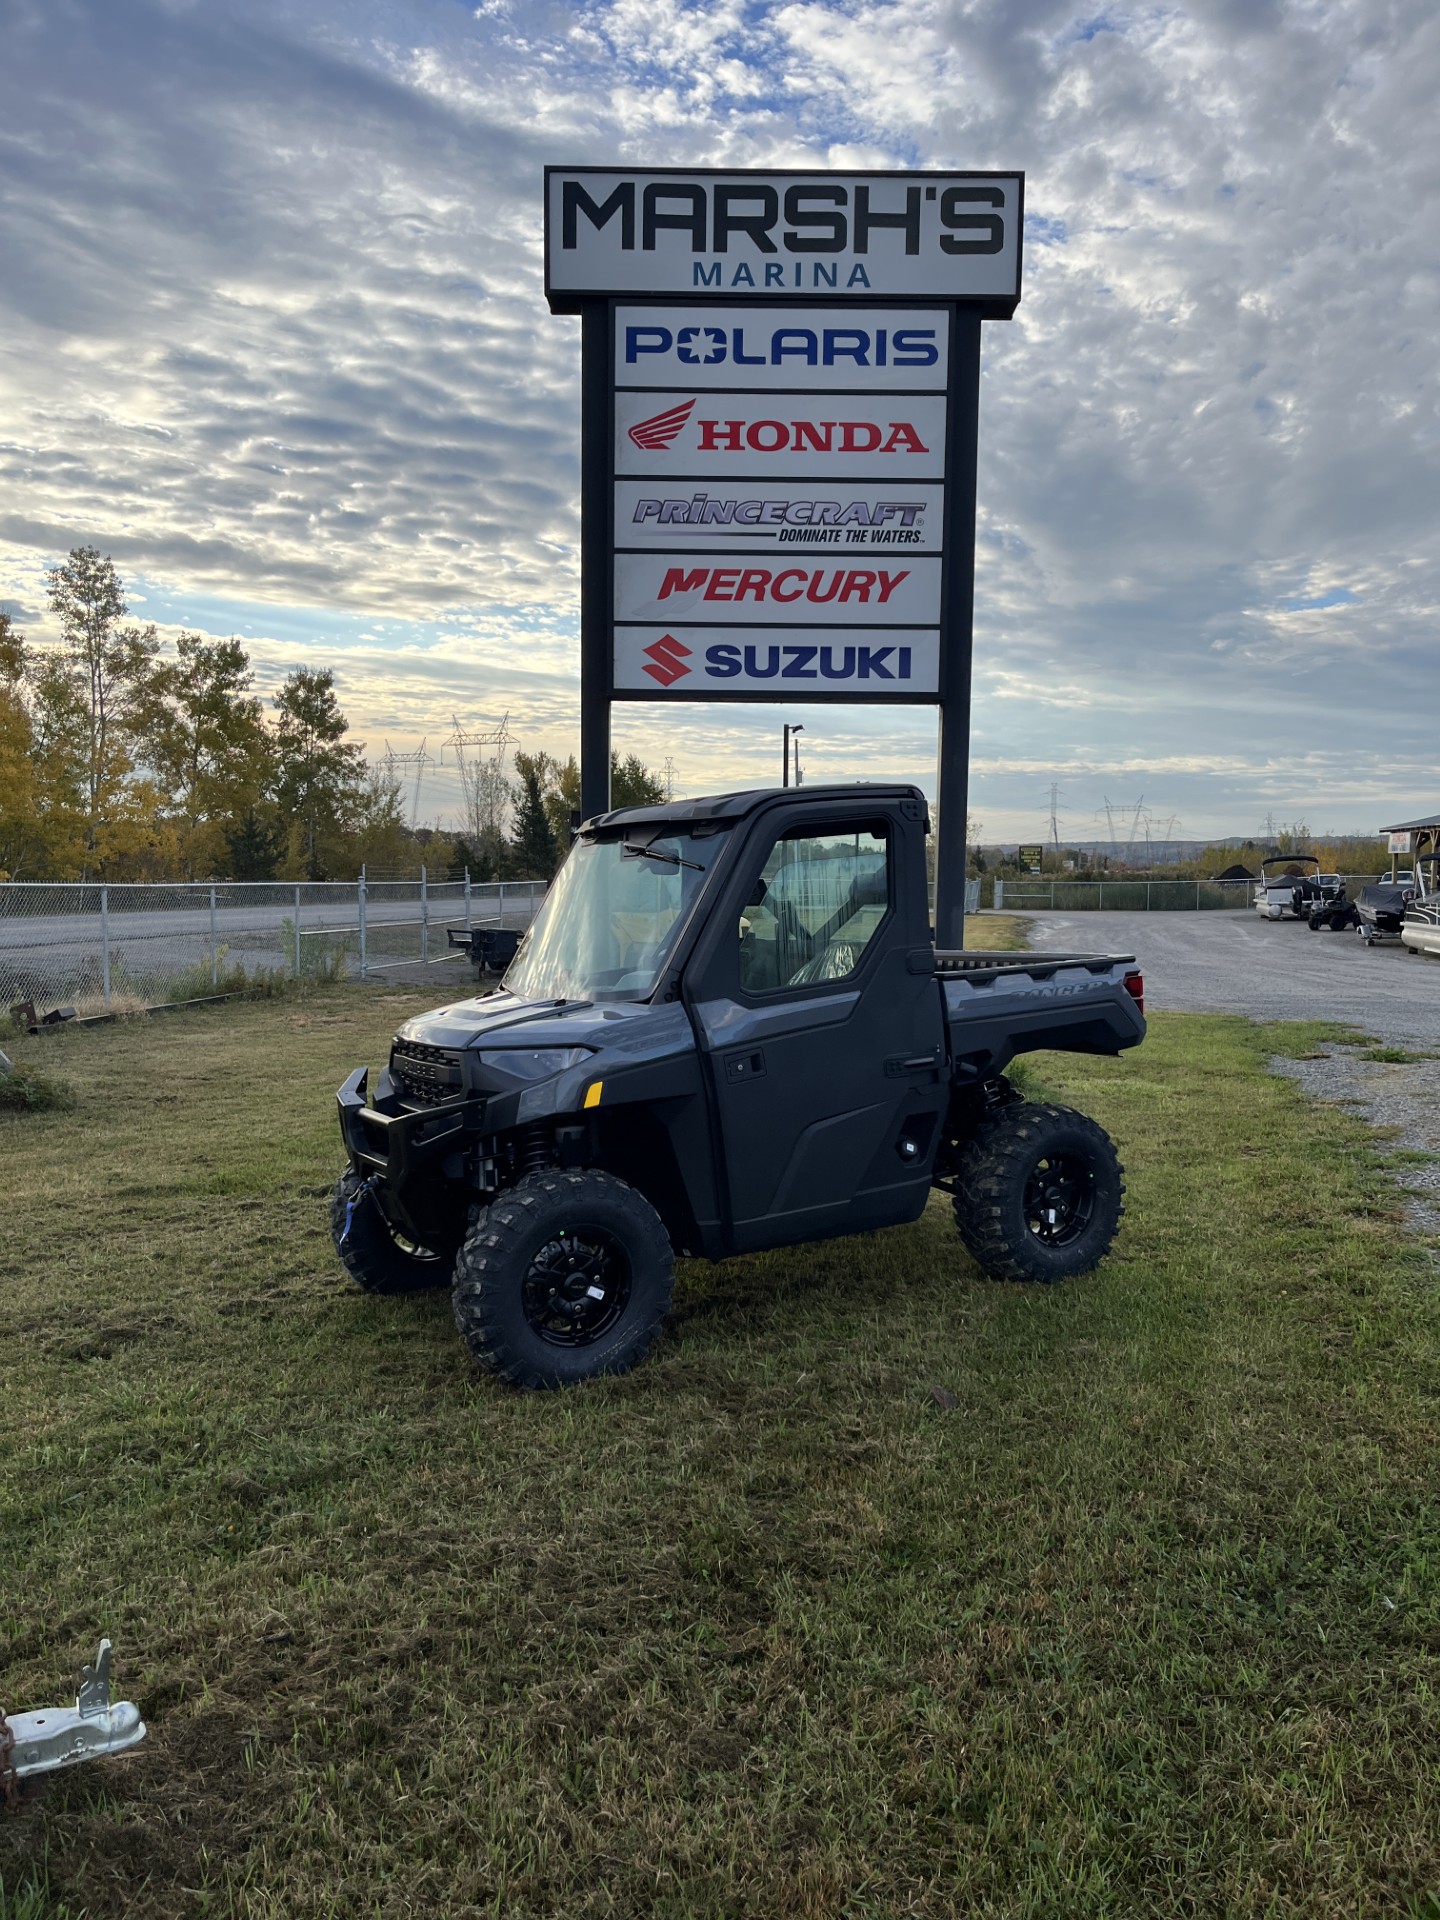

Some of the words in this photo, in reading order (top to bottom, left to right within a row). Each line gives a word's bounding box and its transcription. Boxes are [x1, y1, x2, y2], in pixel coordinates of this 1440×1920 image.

[562, 181, 1005, 255] MARSH'S
[693, 262, 871, 288] MARINA
[625, 326, 939, 367] POLARIS
[697, 420, 930, 453] HONDA
[778, 528, 842, 543] DOMINATE
[845, 529, 869, 543] THE
[657, 568, 911, 603] MERCURY
[704, 645, 912, 679] SUZUKI
